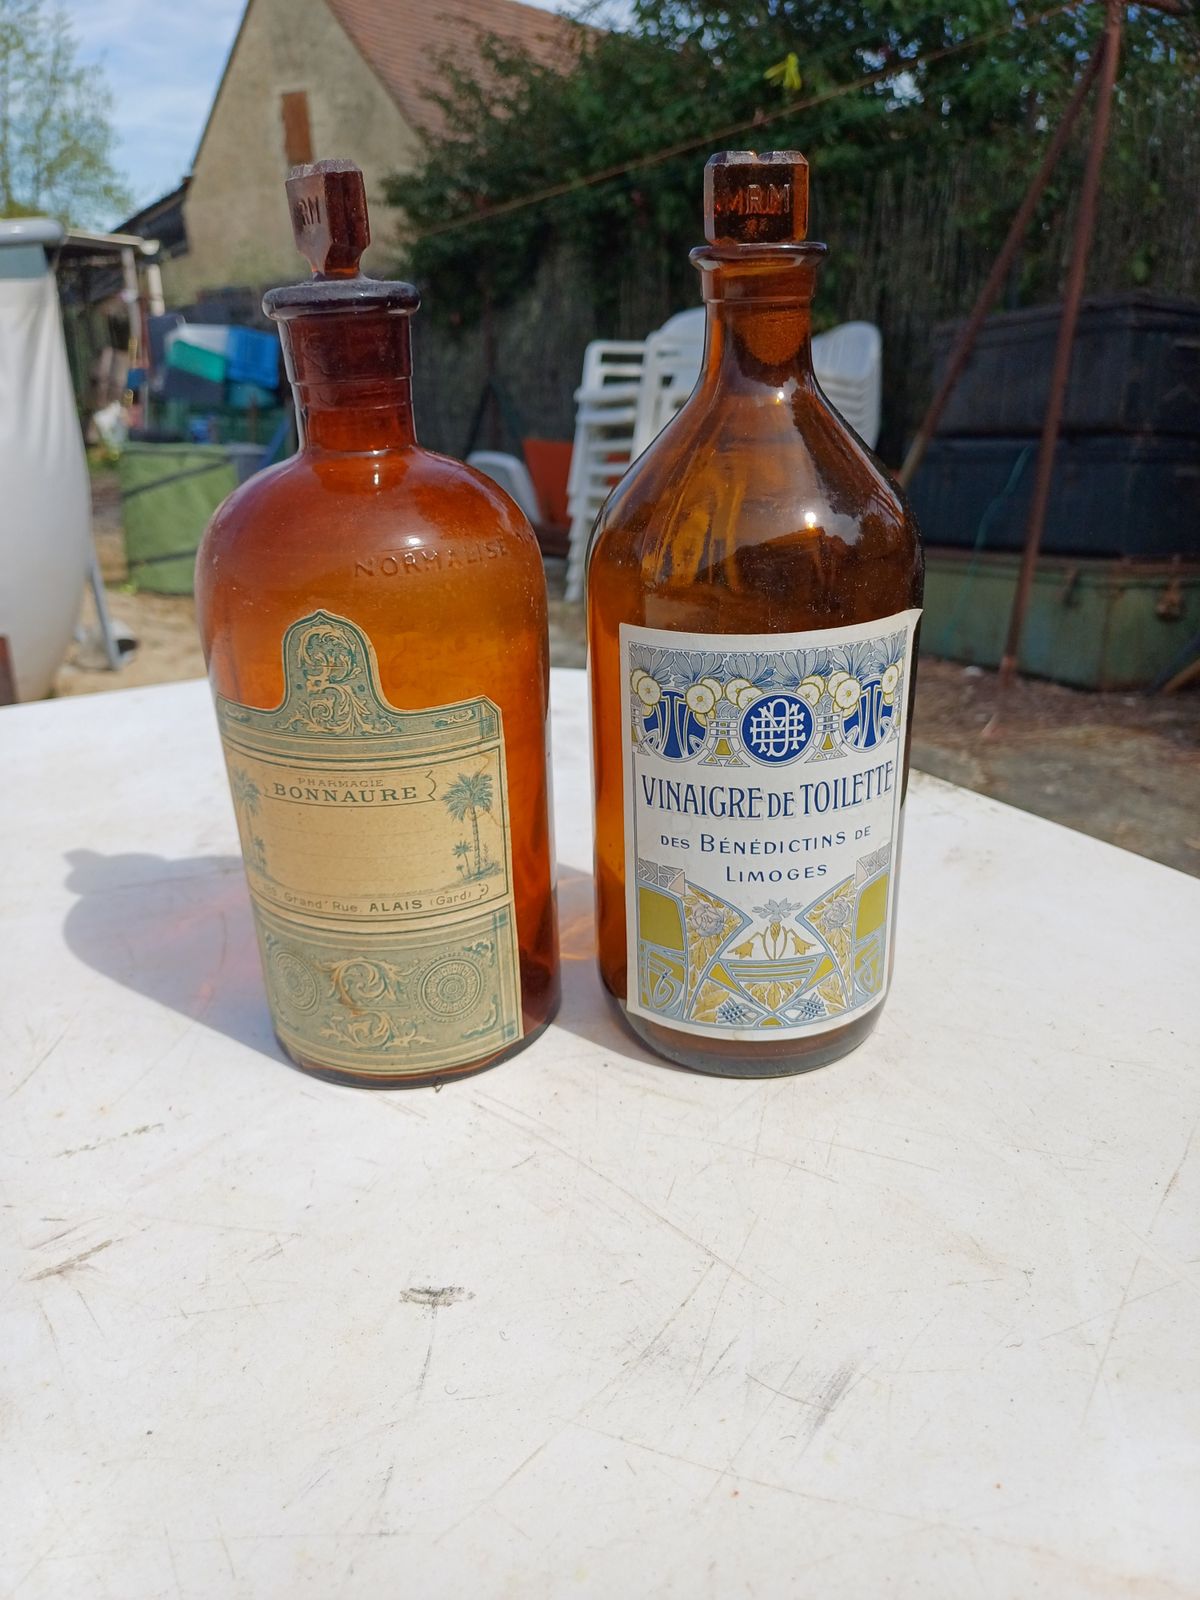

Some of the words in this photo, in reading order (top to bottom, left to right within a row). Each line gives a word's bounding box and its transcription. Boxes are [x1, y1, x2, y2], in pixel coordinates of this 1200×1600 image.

[274, 782, 417, 803] BONNAURE
[298, 777, 384, 788] PHARMACIE
[641, 775, 763, 818] VINAIGRE
[767, 792, 795, 818] DE
[800, 761, 893, 815] TOILETTE
[661, 835, 690, 850] DES
[701, 831, 846, 855] BÉNÉDICTINS
[855, 825, 871, 840] DE
[726, 864, 828, 883] LIMOGES
[369, 899, 423, 913] ALAIS
[430, 890, 472, 907] (Gard)
